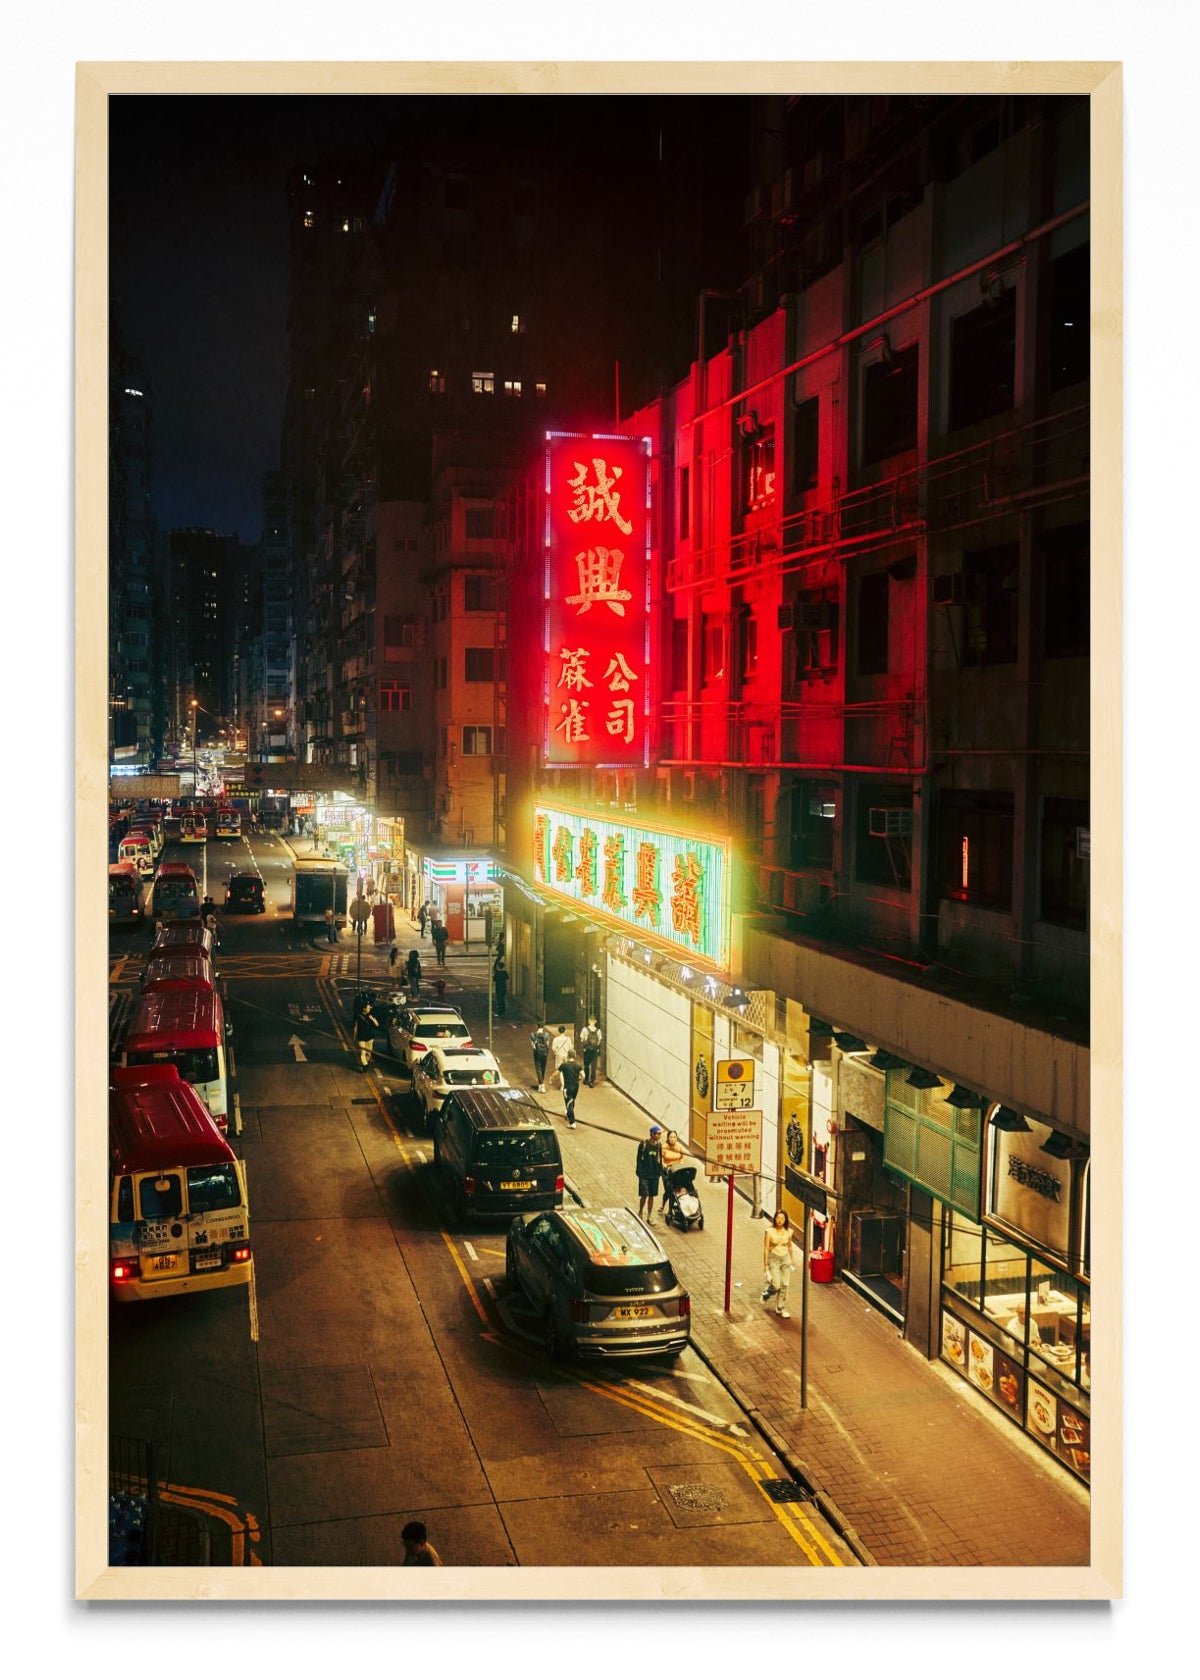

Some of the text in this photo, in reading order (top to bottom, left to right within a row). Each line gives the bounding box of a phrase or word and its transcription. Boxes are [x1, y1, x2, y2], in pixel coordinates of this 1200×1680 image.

[565, 458, 633, 617] 誠興
[603, 652, 638, 744] 公司
[740, 1083, 746, 1093] 7
[740, 1098, 751, 1107] 12
[716, 1142, 751, 1151] 停車等候
[621, 1308, 631, 1316] MX
